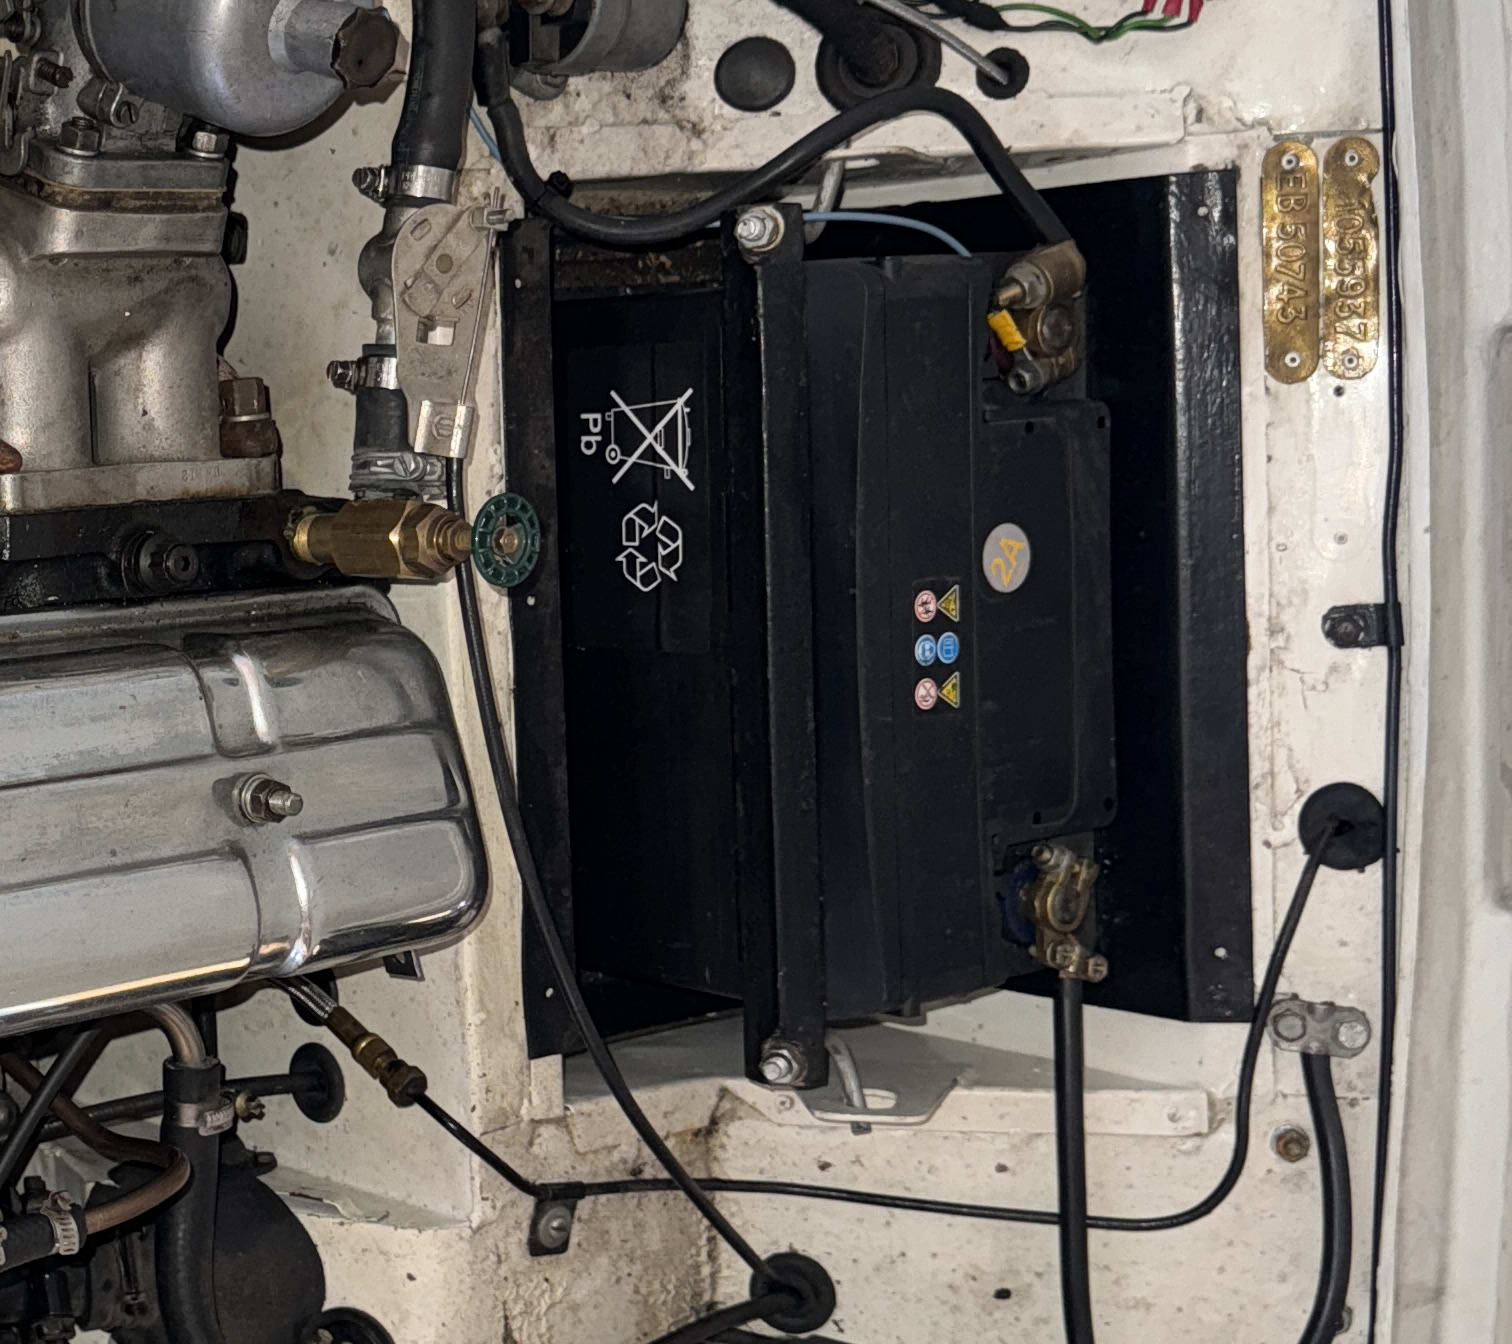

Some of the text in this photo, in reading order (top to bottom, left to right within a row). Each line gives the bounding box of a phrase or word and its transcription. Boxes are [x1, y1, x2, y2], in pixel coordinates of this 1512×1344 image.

[1274, 173, 1309, 325] EB 50743
[580, 413, 603, 455] Pb
